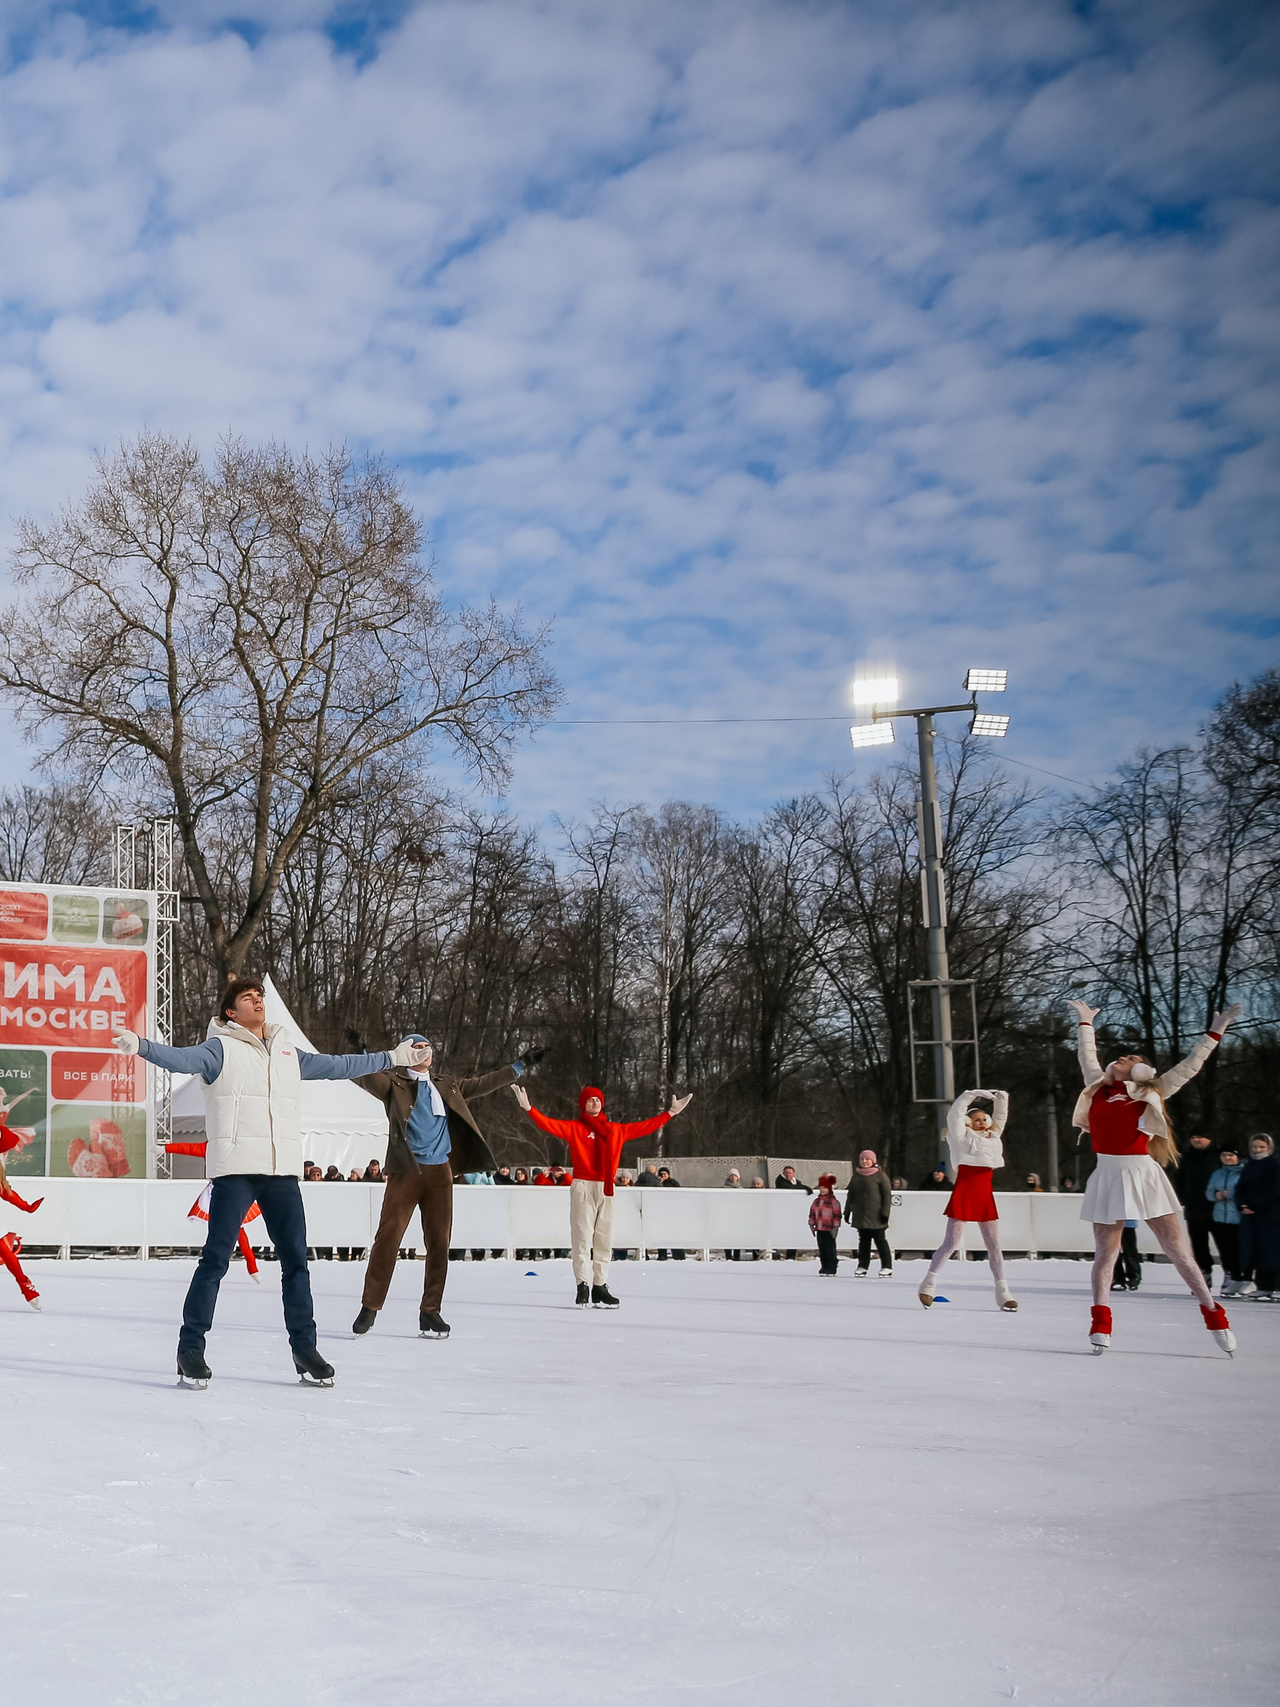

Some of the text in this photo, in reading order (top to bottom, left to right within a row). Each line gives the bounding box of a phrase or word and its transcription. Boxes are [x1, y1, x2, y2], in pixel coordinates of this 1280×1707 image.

[0, 1006, 127, 1031] МОСКВЕ
[63, 1071, 87, 1081] ВСЕ
[91, 1072, 98, 1081] В
